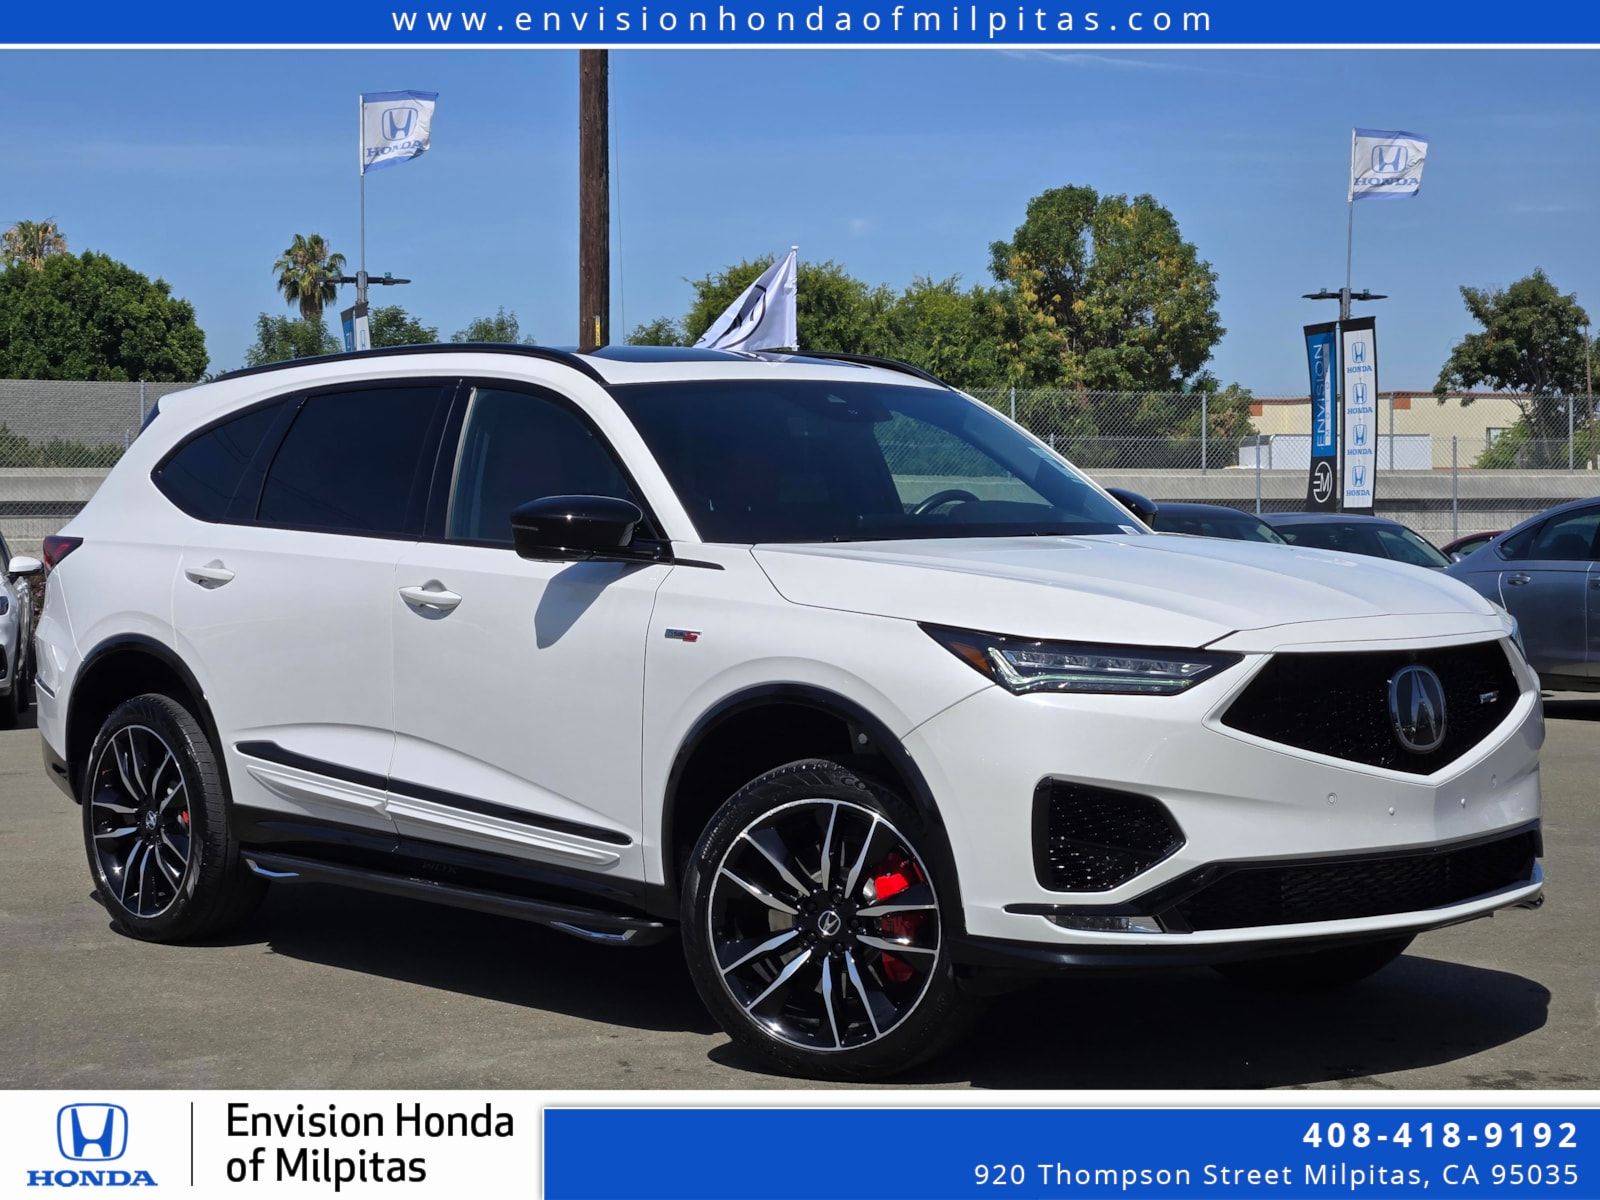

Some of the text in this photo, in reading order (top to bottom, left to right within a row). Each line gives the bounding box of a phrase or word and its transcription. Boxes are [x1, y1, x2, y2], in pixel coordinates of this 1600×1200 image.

[366, 140, 424, 157] HONDA
[1353, 177, 1419, 186] HONDA
[1346, 365, 1372, 374] HONDA
[1313, 343, 1326, 447] ENVISION
[1347, 406, 1373, 415] HONDA
[1347, 447, 1373, 456] HONDA
[1346, 488, 1371, 497] HONDA
